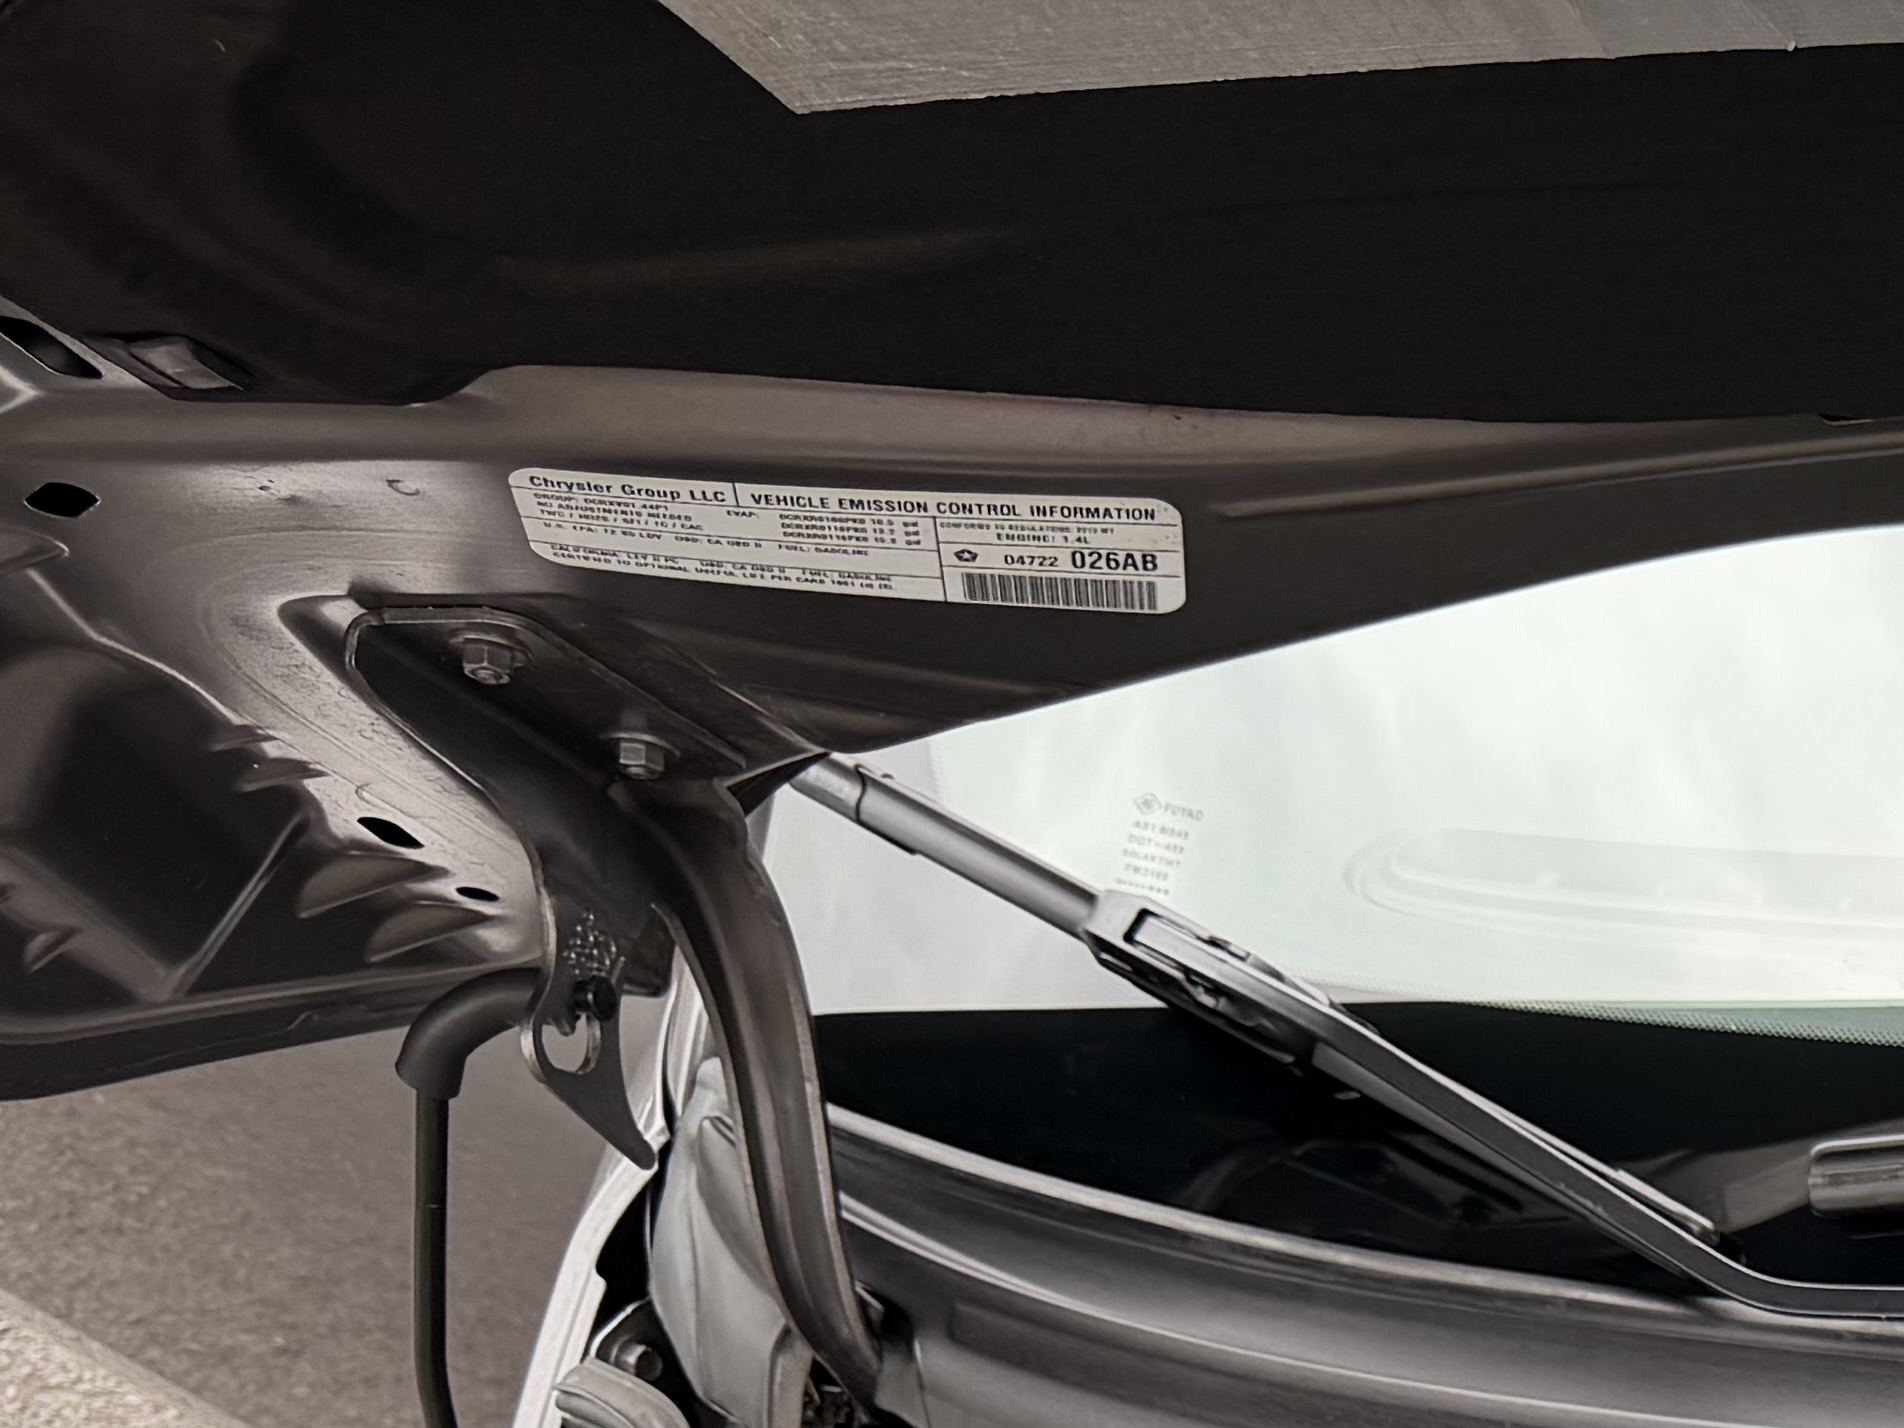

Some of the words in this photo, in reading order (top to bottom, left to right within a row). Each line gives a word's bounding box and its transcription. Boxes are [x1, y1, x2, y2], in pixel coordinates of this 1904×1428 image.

[529, 475, 612, 494] Chrysler
[621, 484, 680, 500] Group
[689, 490, 726, 502] LLC
[750, 493, 831, 509] VEHICLE
[838, 498, 929, 513] EMISSION
[936, 501, 1021, 517] CONTROL
[1029, 505, 1156, 521] INFORMATION
[1004, 554, 1059, 568] 04722
[1071, 550, 1158, 572] 026AB
